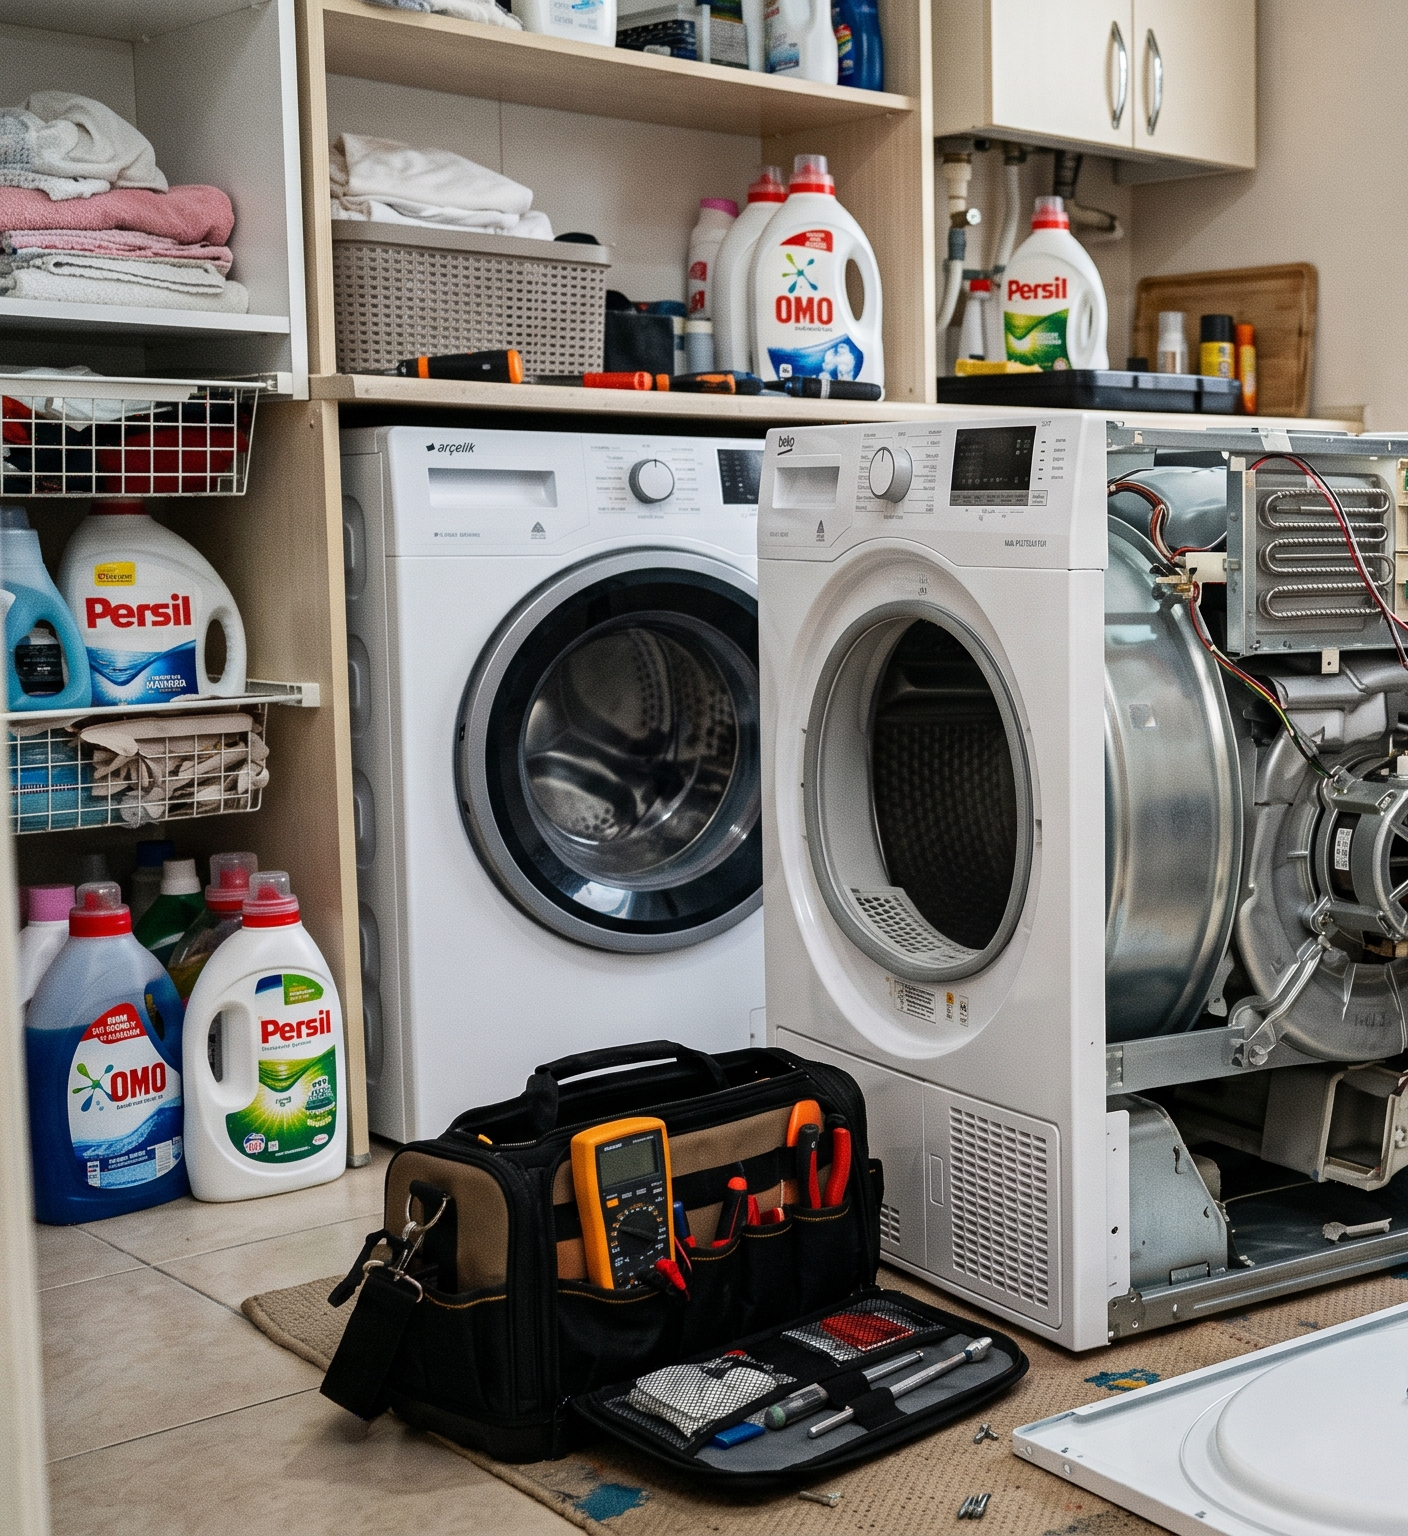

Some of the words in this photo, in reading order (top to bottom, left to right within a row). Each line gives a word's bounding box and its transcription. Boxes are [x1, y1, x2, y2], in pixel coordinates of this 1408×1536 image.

[1007, 276, 1068, 301] Persil
[775, 295, 833, 325] OMO
[437, 442, 476, 456] arçelik
[778, 435, 795, 448] beko
[85, 593, 192, 629] Persil
[260, 1009, 332, 1044] Persil
[110, 1062, 167, 1103] OMO
